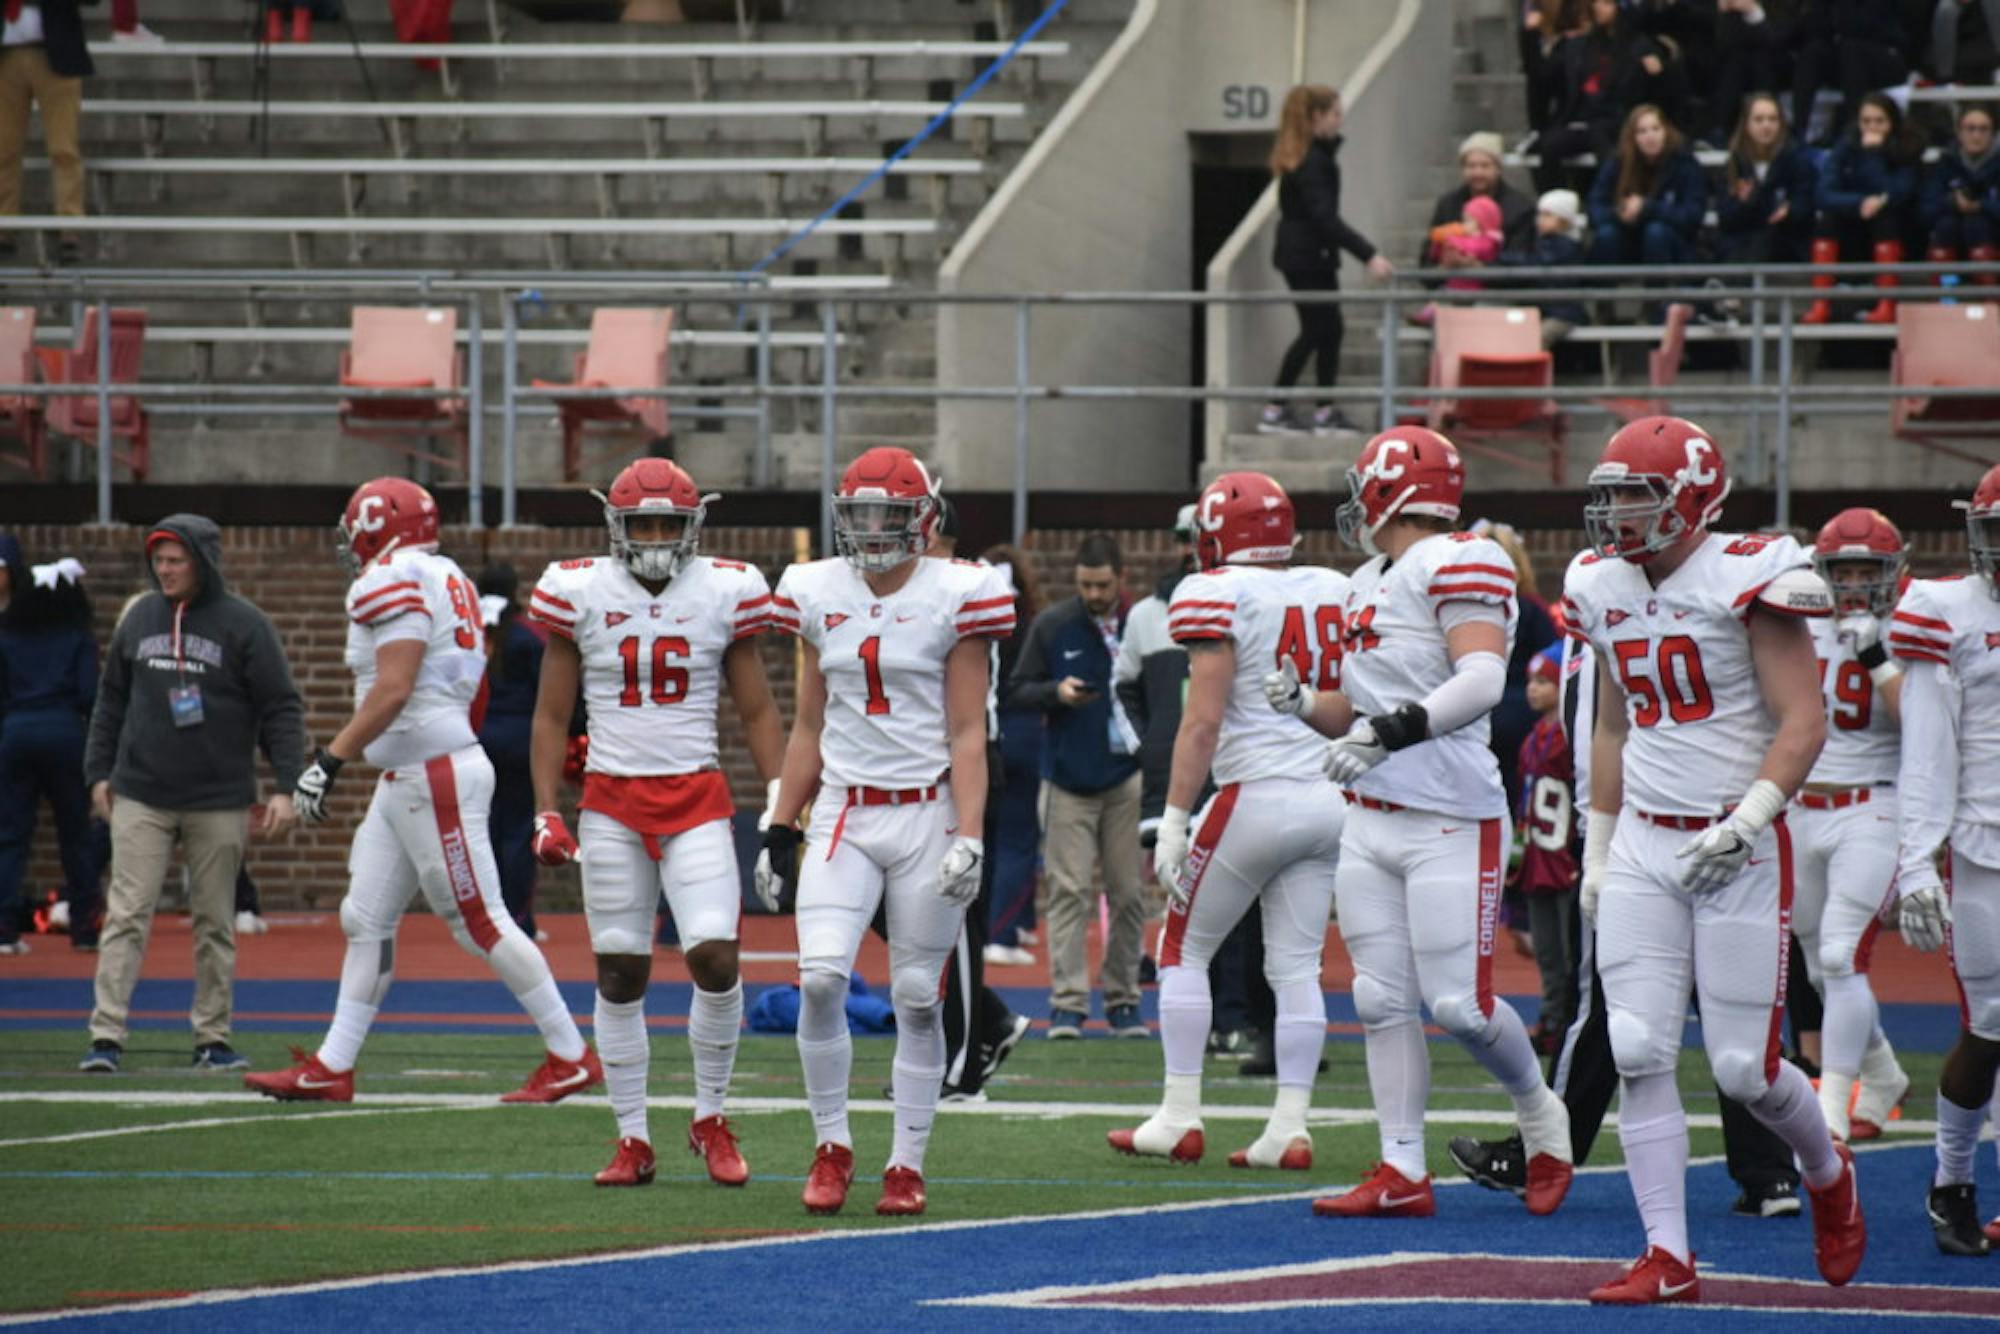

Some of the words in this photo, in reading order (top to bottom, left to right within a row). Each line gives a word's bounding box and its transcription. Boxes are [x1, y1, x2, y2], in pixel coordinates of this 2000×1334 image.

[1222, 85, 1270, 120] SD
[1376, 439, 1408, 479] C
[1684, 437, 1718, 486] C
[359, 496, 385, 532] C
[1203, 491, 1226, 532] C
[618, 634, 690, 706] 16
[858, 634, 891, 715] 1
[1274, 604, 1345, 692] 48
[1613, 634, 1714, 728] 50
[442, 827, 477, 901] CORNELL
[1480, 865, 1499, 957] CORNELL
